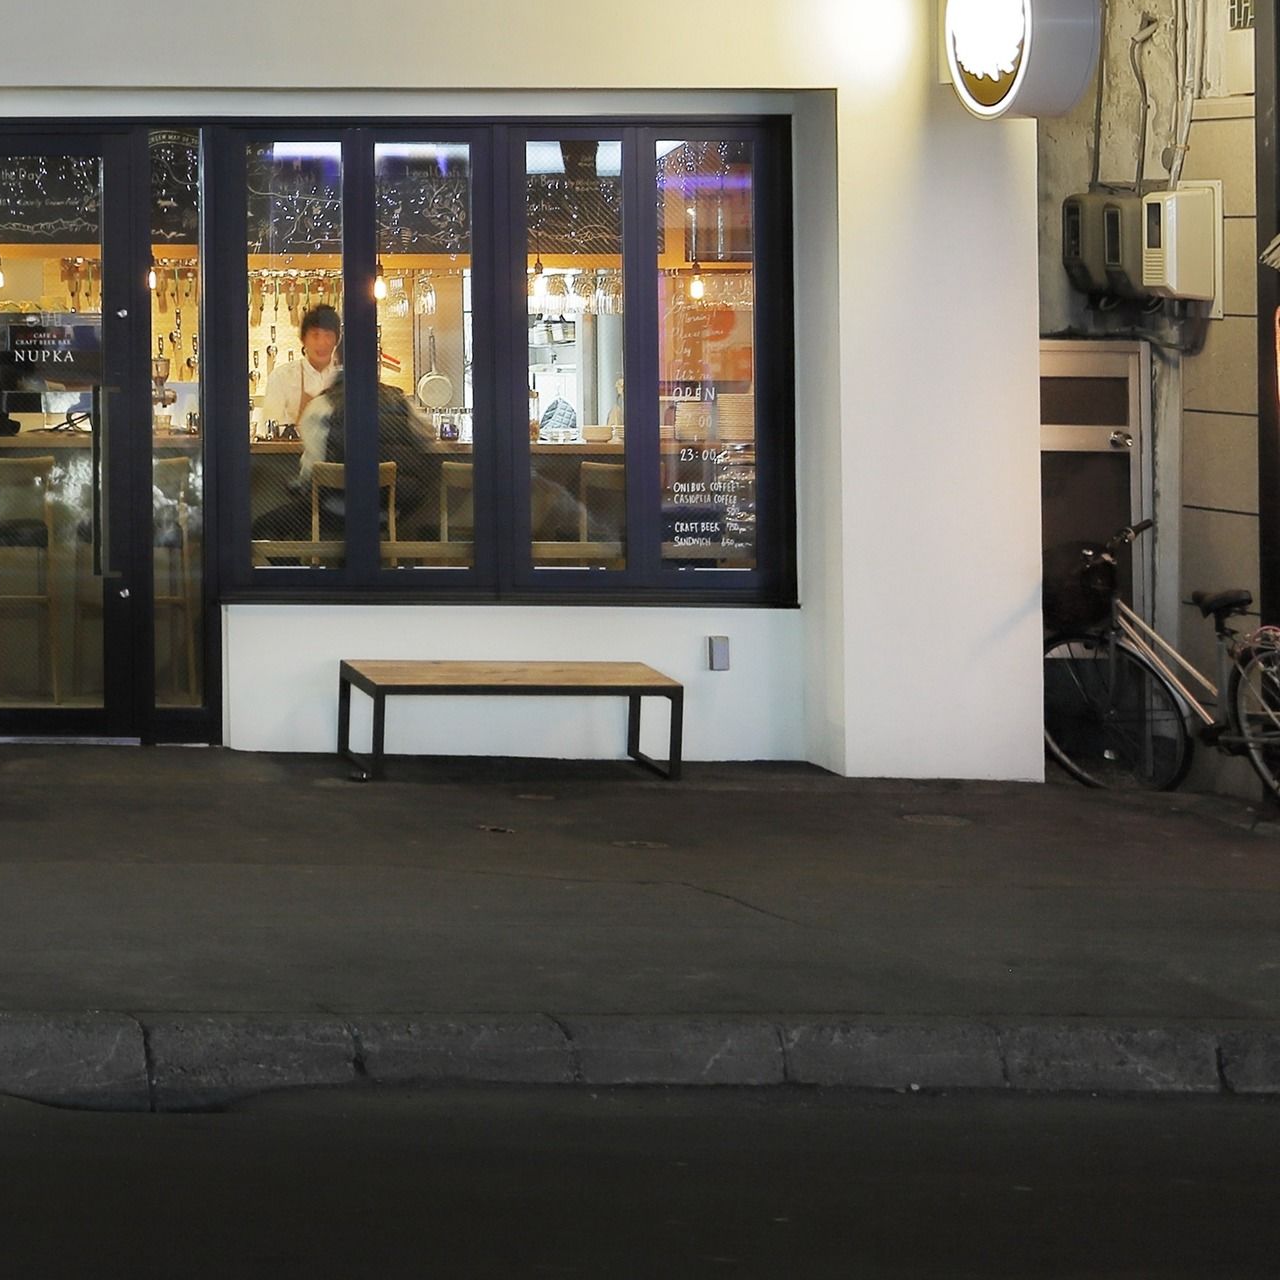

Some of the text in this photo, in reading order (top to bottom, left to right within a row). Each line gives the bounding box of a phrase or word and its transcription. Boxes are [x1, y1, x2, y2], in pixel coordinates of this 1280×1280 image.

[14, 349, 75, 363] NUPKA
[672, 386, 716, 401] OPEN
[680, 448, 717, 462] 23:00
[673, 482, 737, 493] ONIBUS COFFEE
[713, 494, 737, 506] COFFEE
[674, 522, 699, 533] CRAFT
[700, 522, 720, 533] BEER
